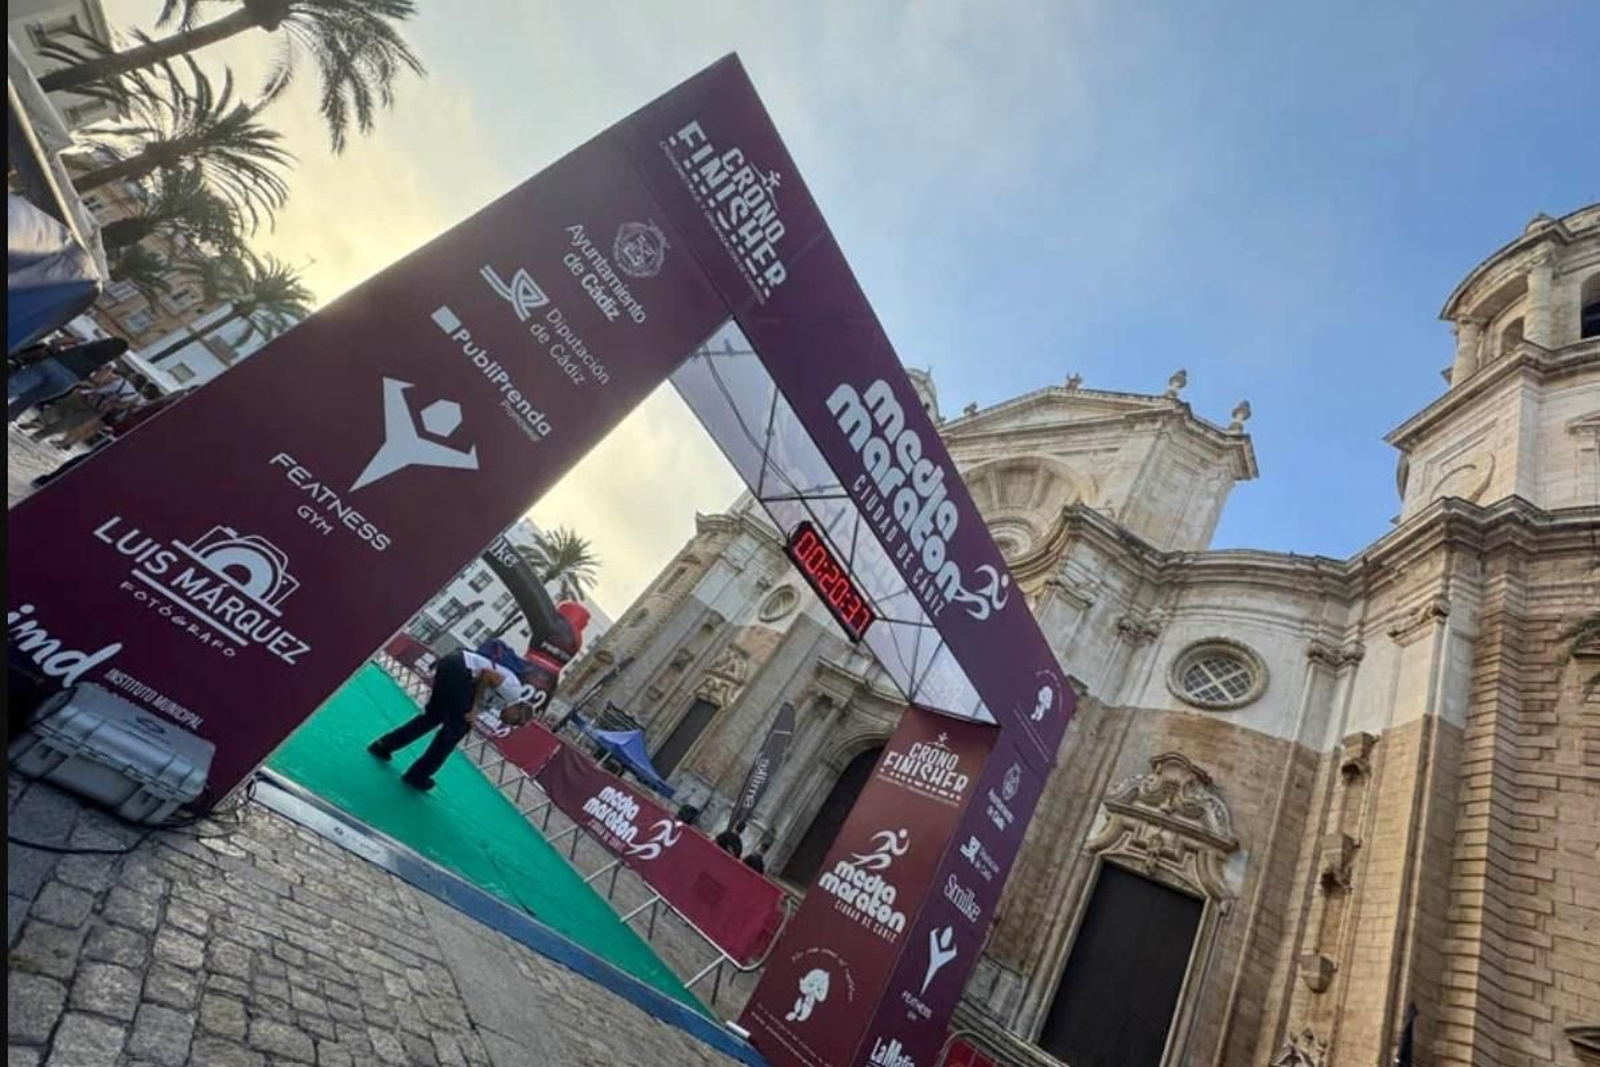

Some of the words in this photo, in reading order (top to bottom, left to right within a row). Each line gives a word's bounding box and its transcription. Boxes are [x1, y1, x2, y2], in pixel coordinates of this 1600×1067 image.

[676, 120, 787, 287] FINISHER
[721, 147, 785, 243] CRONO
[563, 252, 583, 277] de
[581, 273, 621, 322] Cádiz
[564, 223, 646, 324] Ayuntamiento
[452, 328, 552, 437] PubliPrenda
[530, 322, 550, 344] de
[550, 342, 585, 386] Cádiz
[546, 308, 610, 386] Diputación
[269, 453, 391, 551] FEATNESS
[826, 383, 962, 604] maraton
[863, 379, 959, 543] media
[296, 505, 334, 535] GYM
[853, 475, 899, 542] CIUDAD
[896, 542, 914, 569] DE
[93, 516, 178, 574] LUIS
[170, 567, 312, 665] MÁRQUEZ
[794, 530, 870, 640] 00:20:37
[104, 668, 158, 702] INSTITUTO
[151, 695, 203, 730] MUNICIPAL
[883, 750, 969, 792] FINISHER
[909, 742, 959, 771] CRONO
[582, 797, 638, 843] maraton
[818, 872, 906, 934] maraton
[834, 861, 897, 905] media
